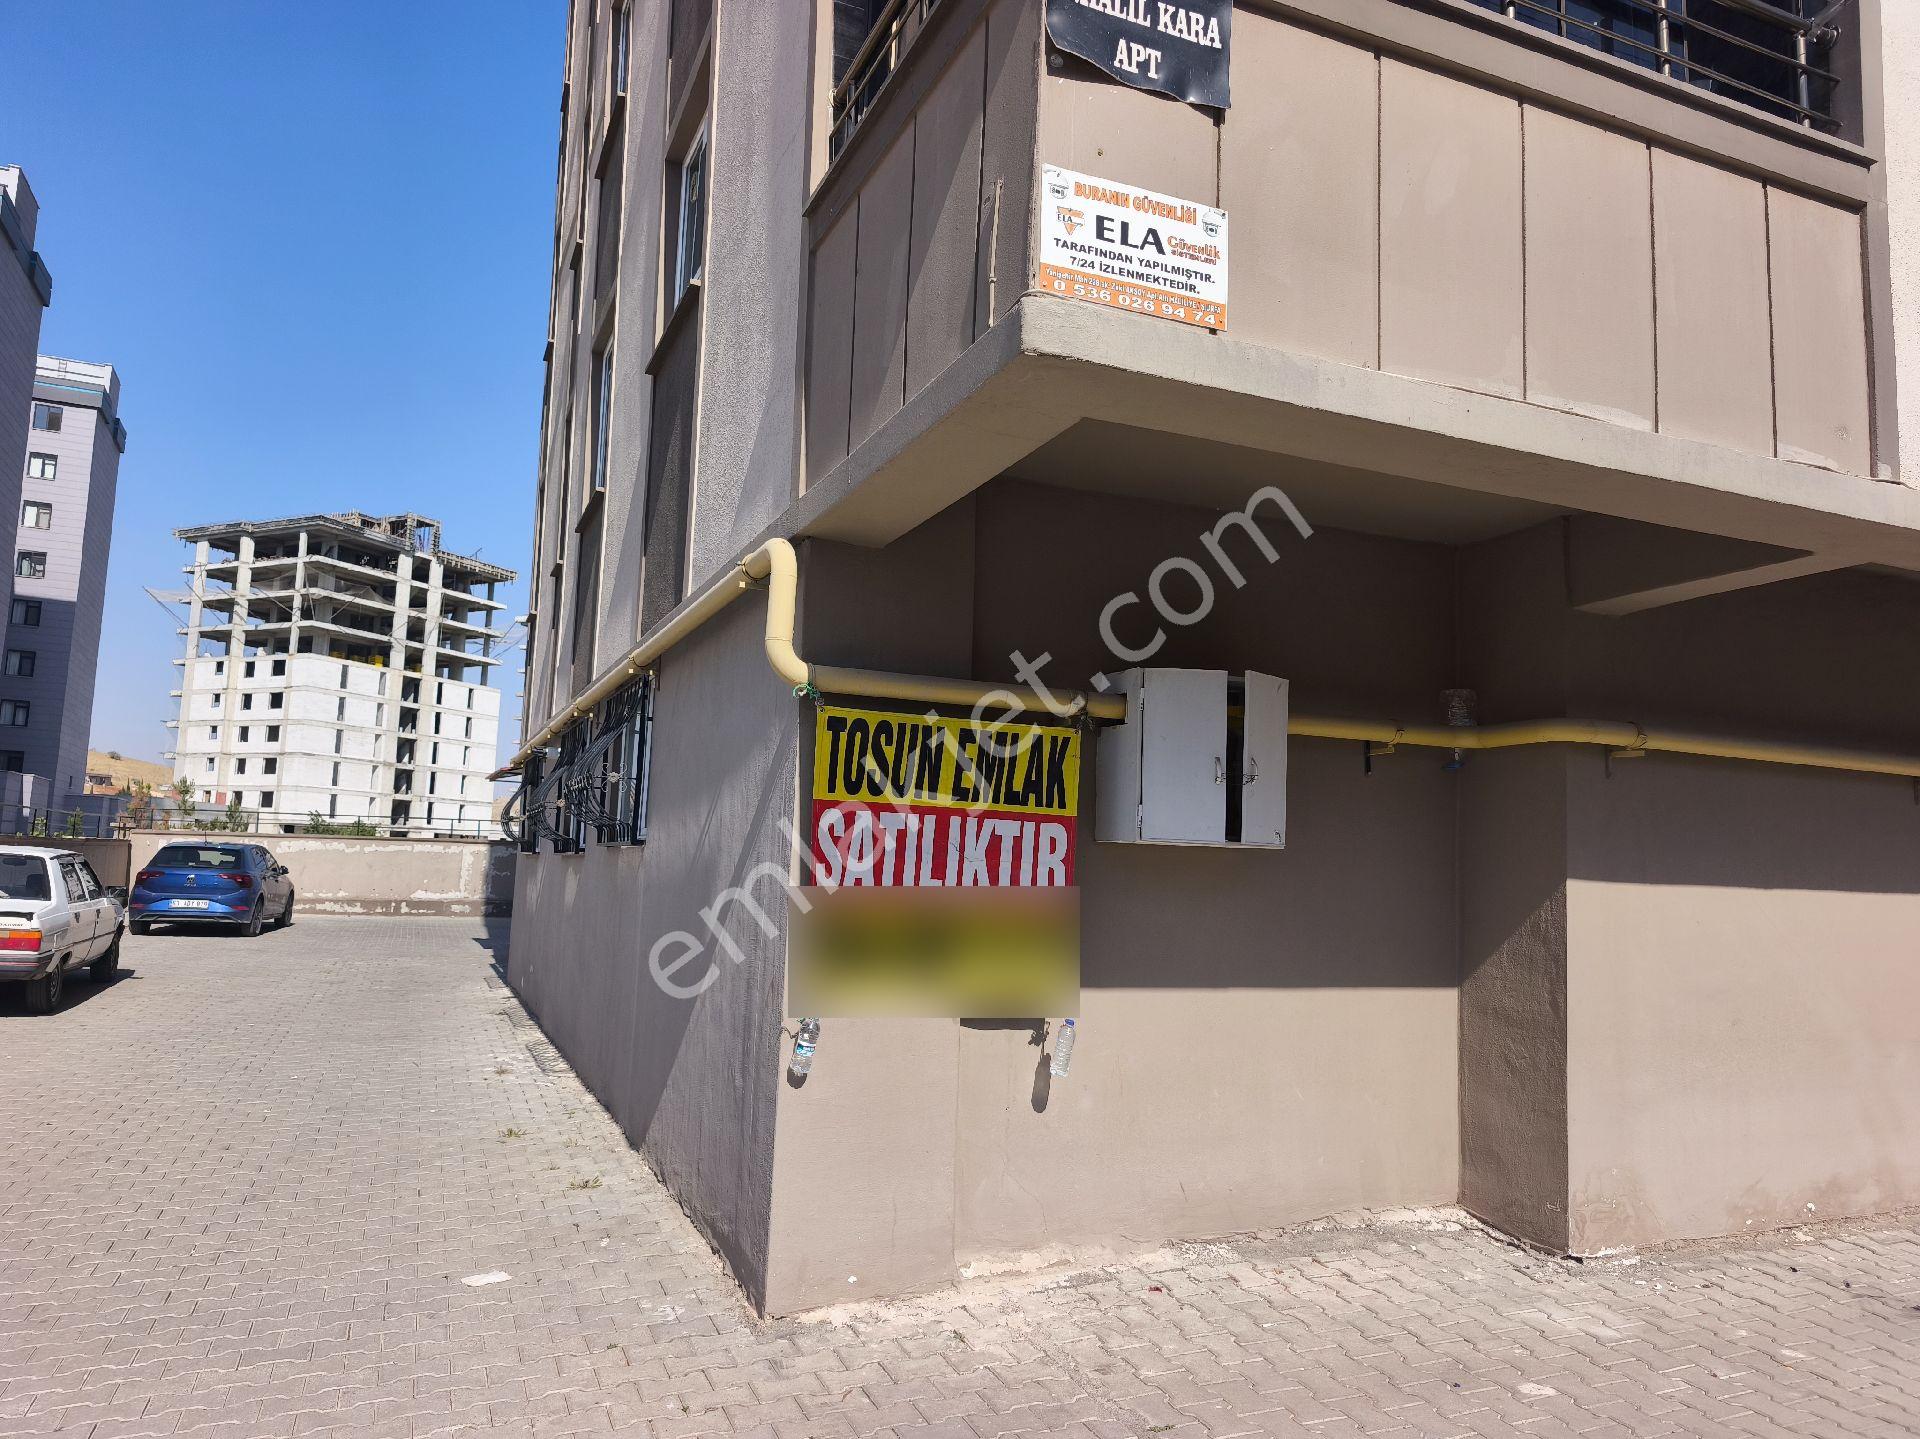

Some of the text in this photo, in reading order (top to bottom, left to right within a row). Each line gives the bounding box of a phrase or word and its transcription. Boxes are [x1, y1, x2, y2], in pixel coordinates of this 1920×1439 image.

[1075, 0, 1222, 49] ALIL KARA
[1113, 38, 1162, 79] APT
[1057, 213, 1073, 223] ELA
[1074, 181, 1197, 225] BURANIN GÜVENLİĞİ
[1096, 215, 1167, 255] ELA
[1053, 237, 1216, 284] TARAFINDAN YAPILMIŞTIR.
[1069, 255, 1200, 294] 7/24 İZLENMEKTEDİR.
[1053, 280, 1216, 325] 0 536 026 94 74
[826, 716, 1071, 810] TOSUN EMLAK
[815, 808, 1068, 887] SATILIKTIR
